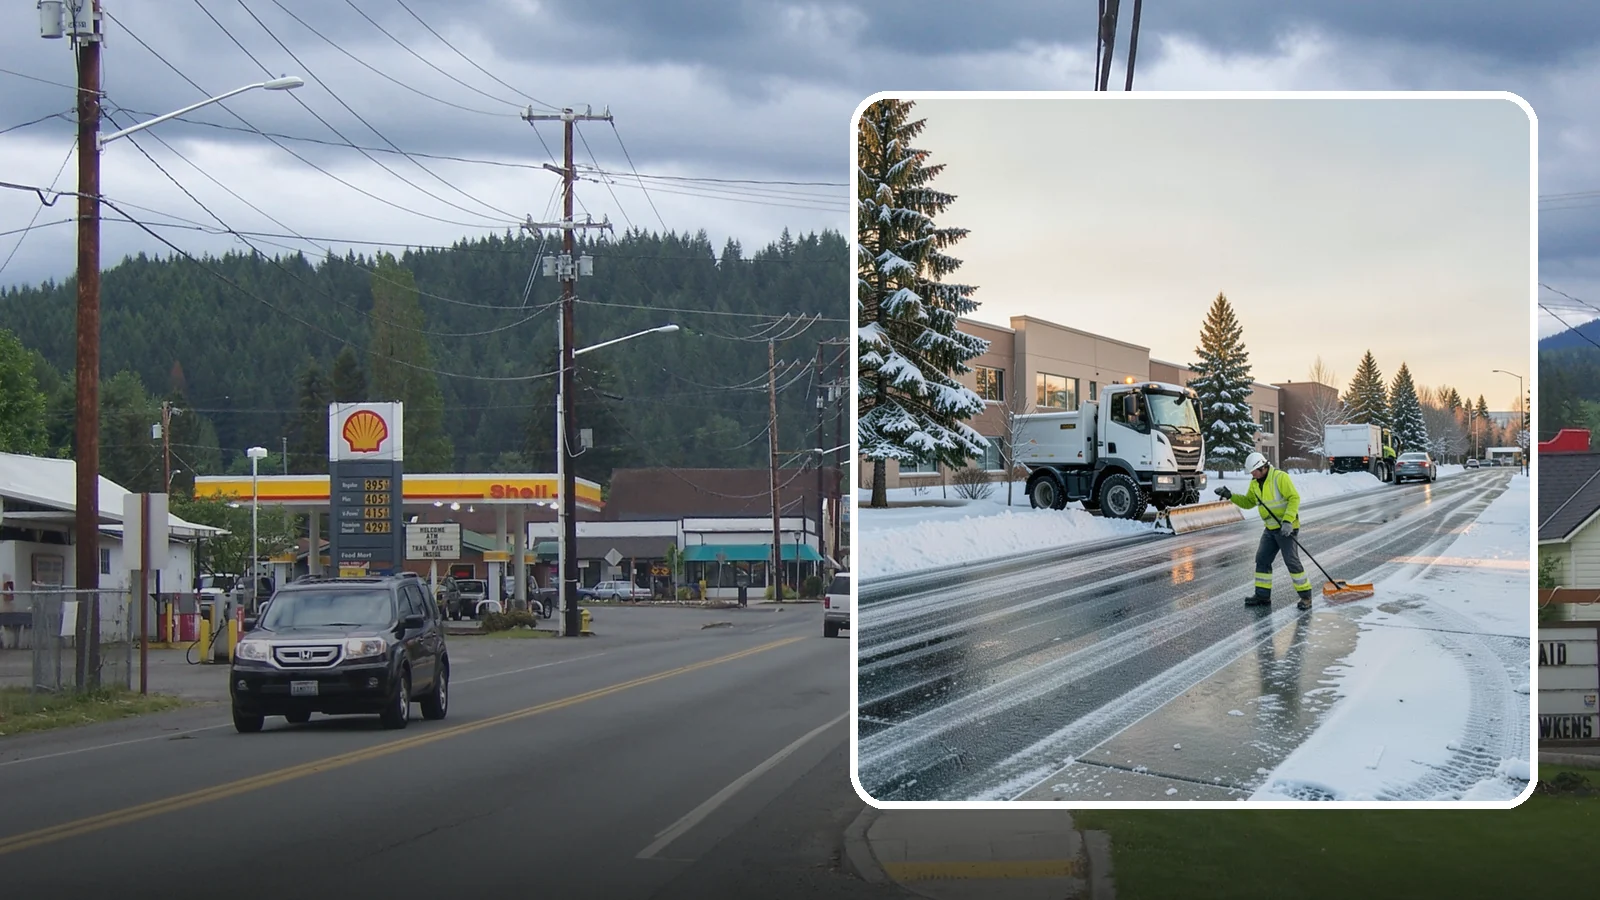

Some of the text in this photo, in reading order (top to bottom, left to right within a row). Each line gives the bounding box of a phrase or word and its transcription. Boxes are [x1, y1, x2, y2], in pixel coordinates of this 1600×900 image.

[366, 480, 383, 490] 395
[490, 484, 547, 499] Shell
[366, 494, 383, 504] 405
